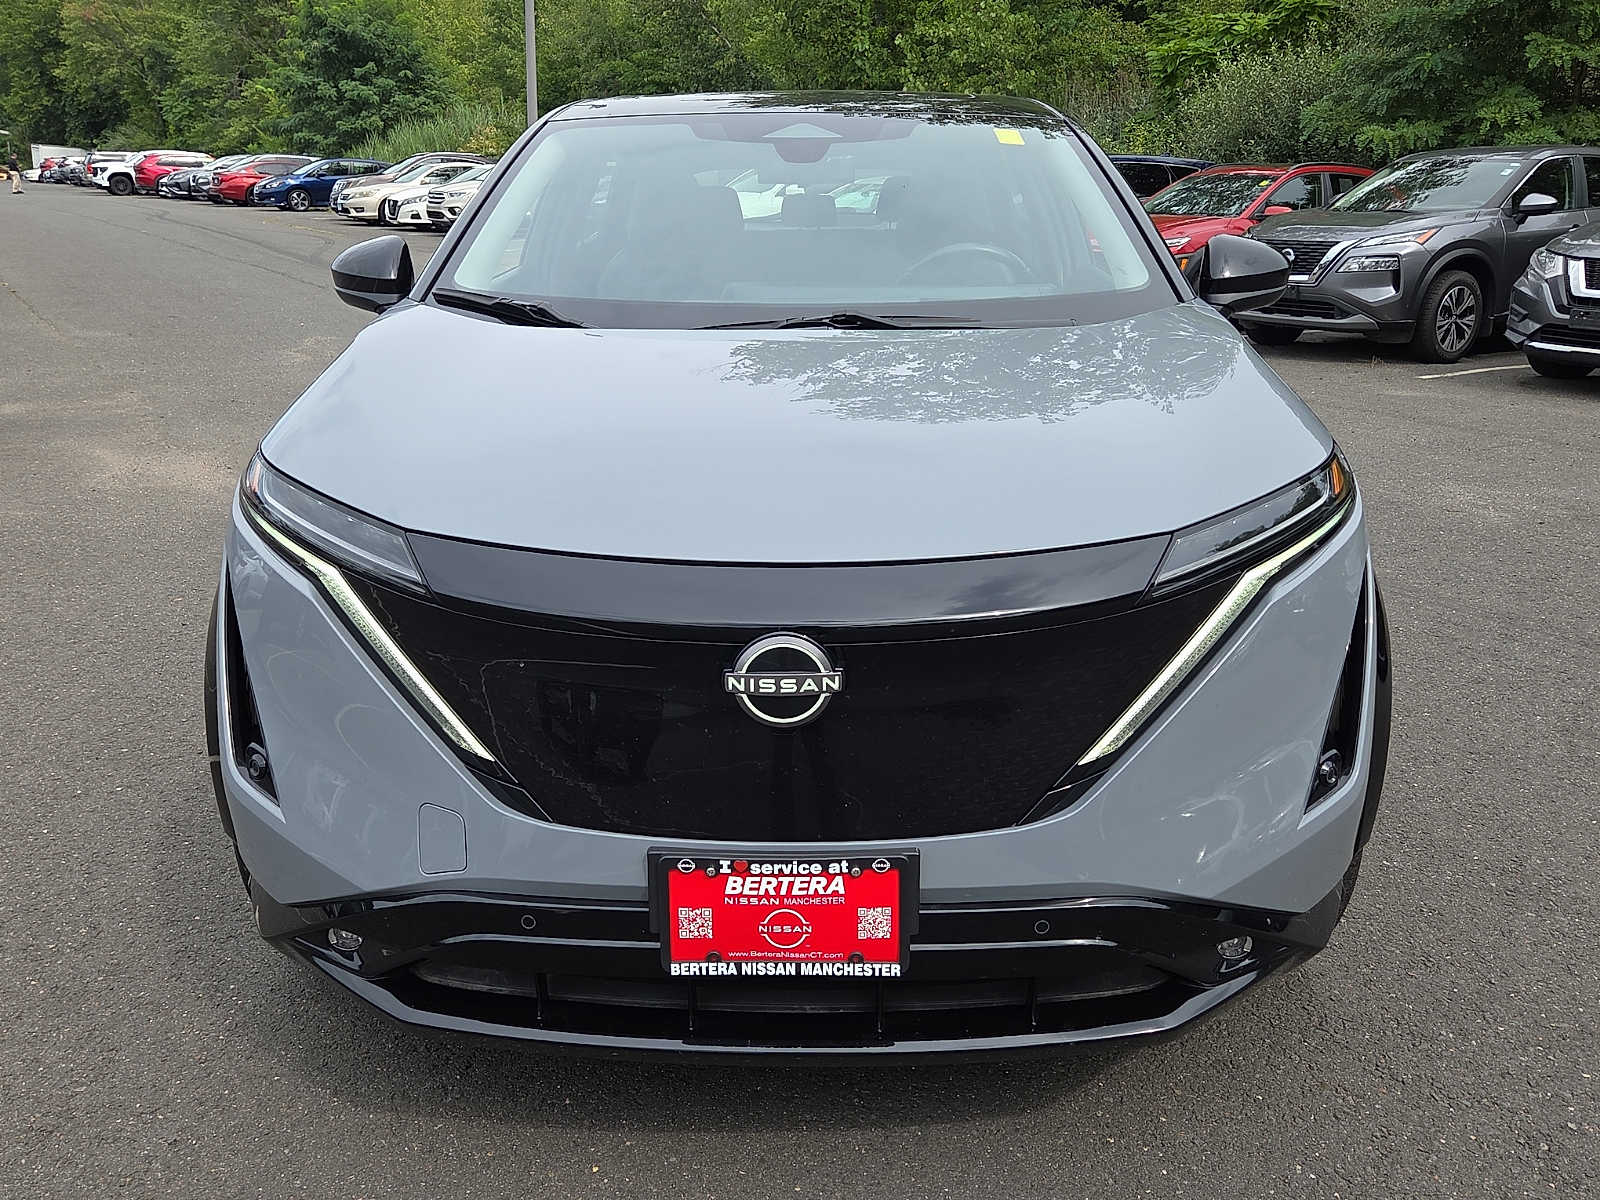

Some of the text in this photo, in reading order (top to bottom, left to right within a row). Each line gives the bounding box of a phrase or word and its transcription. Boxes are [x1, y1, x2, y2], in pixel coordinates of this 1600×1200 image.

[727, 675, 840, 694] NISSAN
[719, 859, 849, 875] I service at
[725, 876, 846, 896] BERTERA
[724, 896, 845, 905] NISSAN MANCHESTER
[758, 924, 813, 933] NISSAN
[728, 951, 844, 960] www.BerteraNissanCT.com
[670, 962, 901, 977] BERTERA NISSAN MANCHESTER
